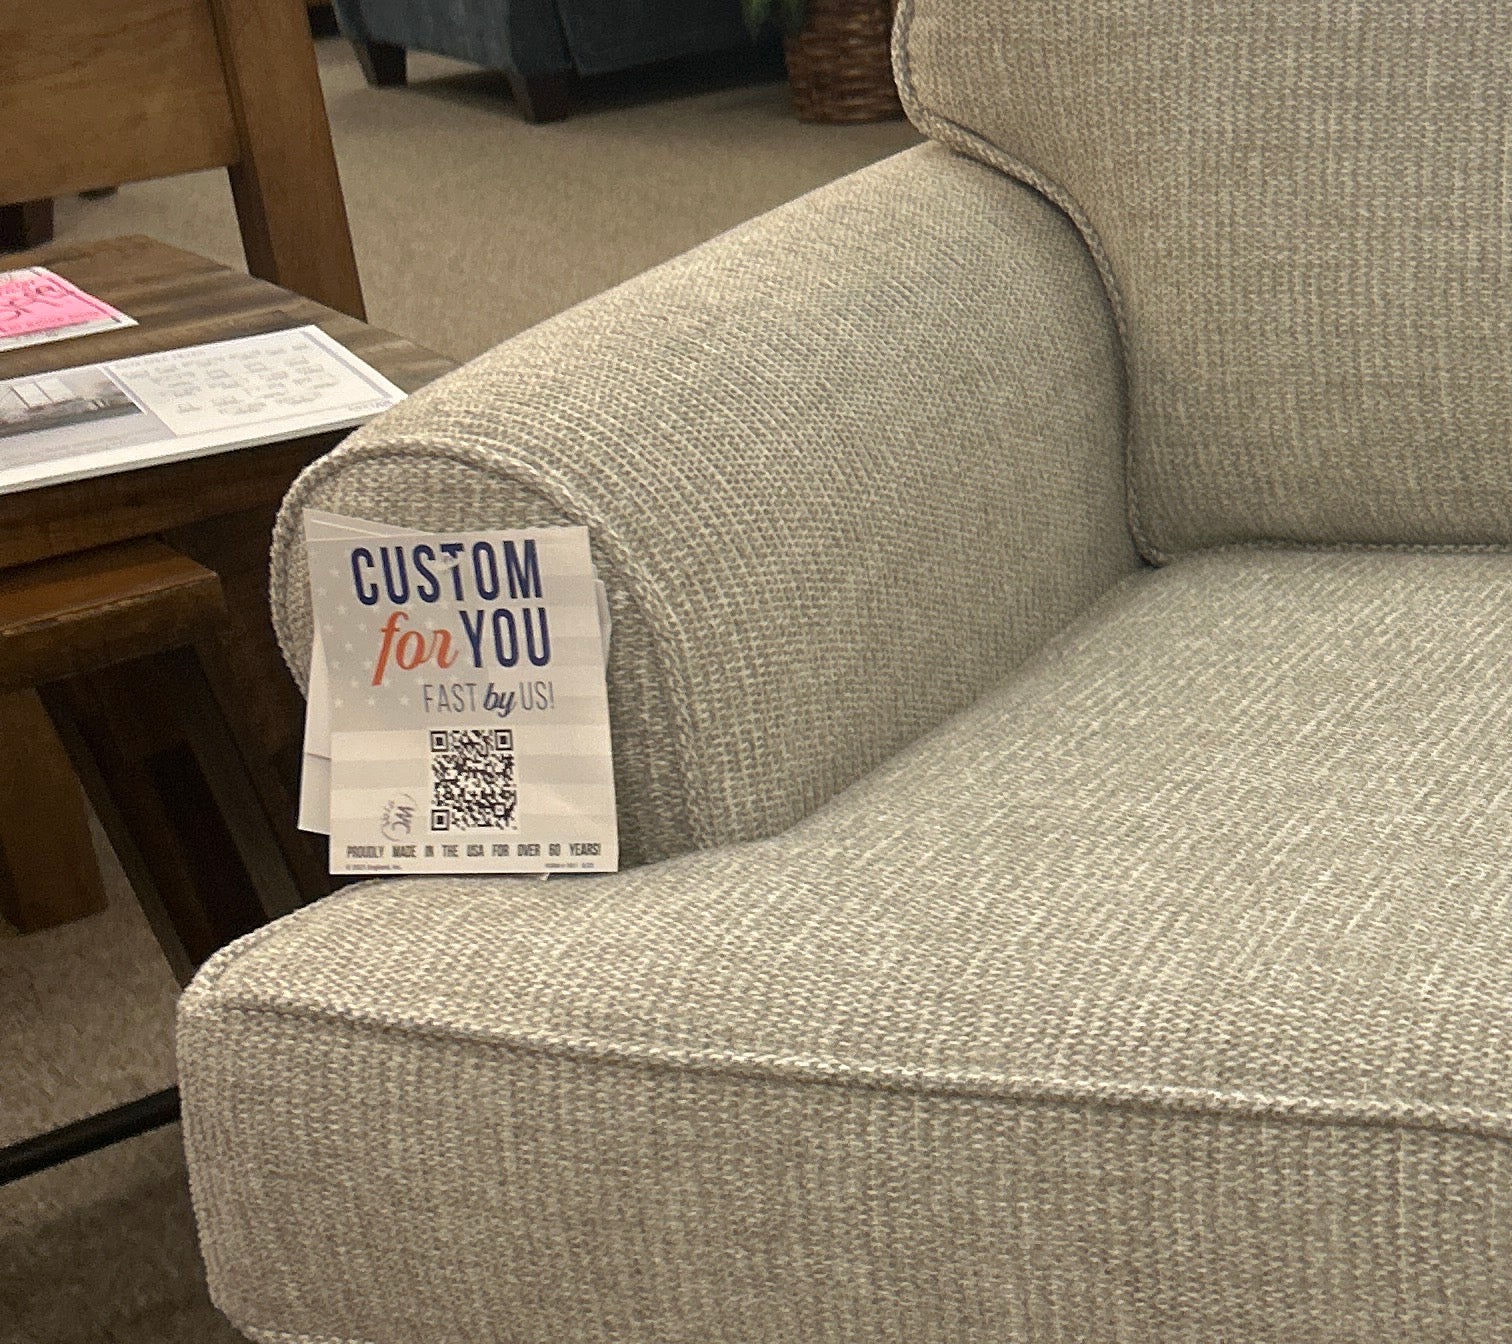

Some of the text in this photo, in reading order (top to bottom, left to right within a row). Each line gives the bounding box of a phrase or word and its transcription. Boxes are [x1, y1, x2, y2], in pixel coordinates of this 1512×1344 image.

[351, 539, 544, 605] CUSTOM
[371, 607, 552, 687] for YOU
[422, 680, 555, 718] FAST by US!
[346, 845, 385, 858] PROUDLY
[391, 845, 417, 858] MADE
[425, 845, 434, 857] IN
[442, 844, 459, 857] THE
[466, 844, 485, 857] USA
[492, 844, 510, 857] FOR
[517, 843, 541, 857] OVER
[569, 842, 602, 856] YEARS!
